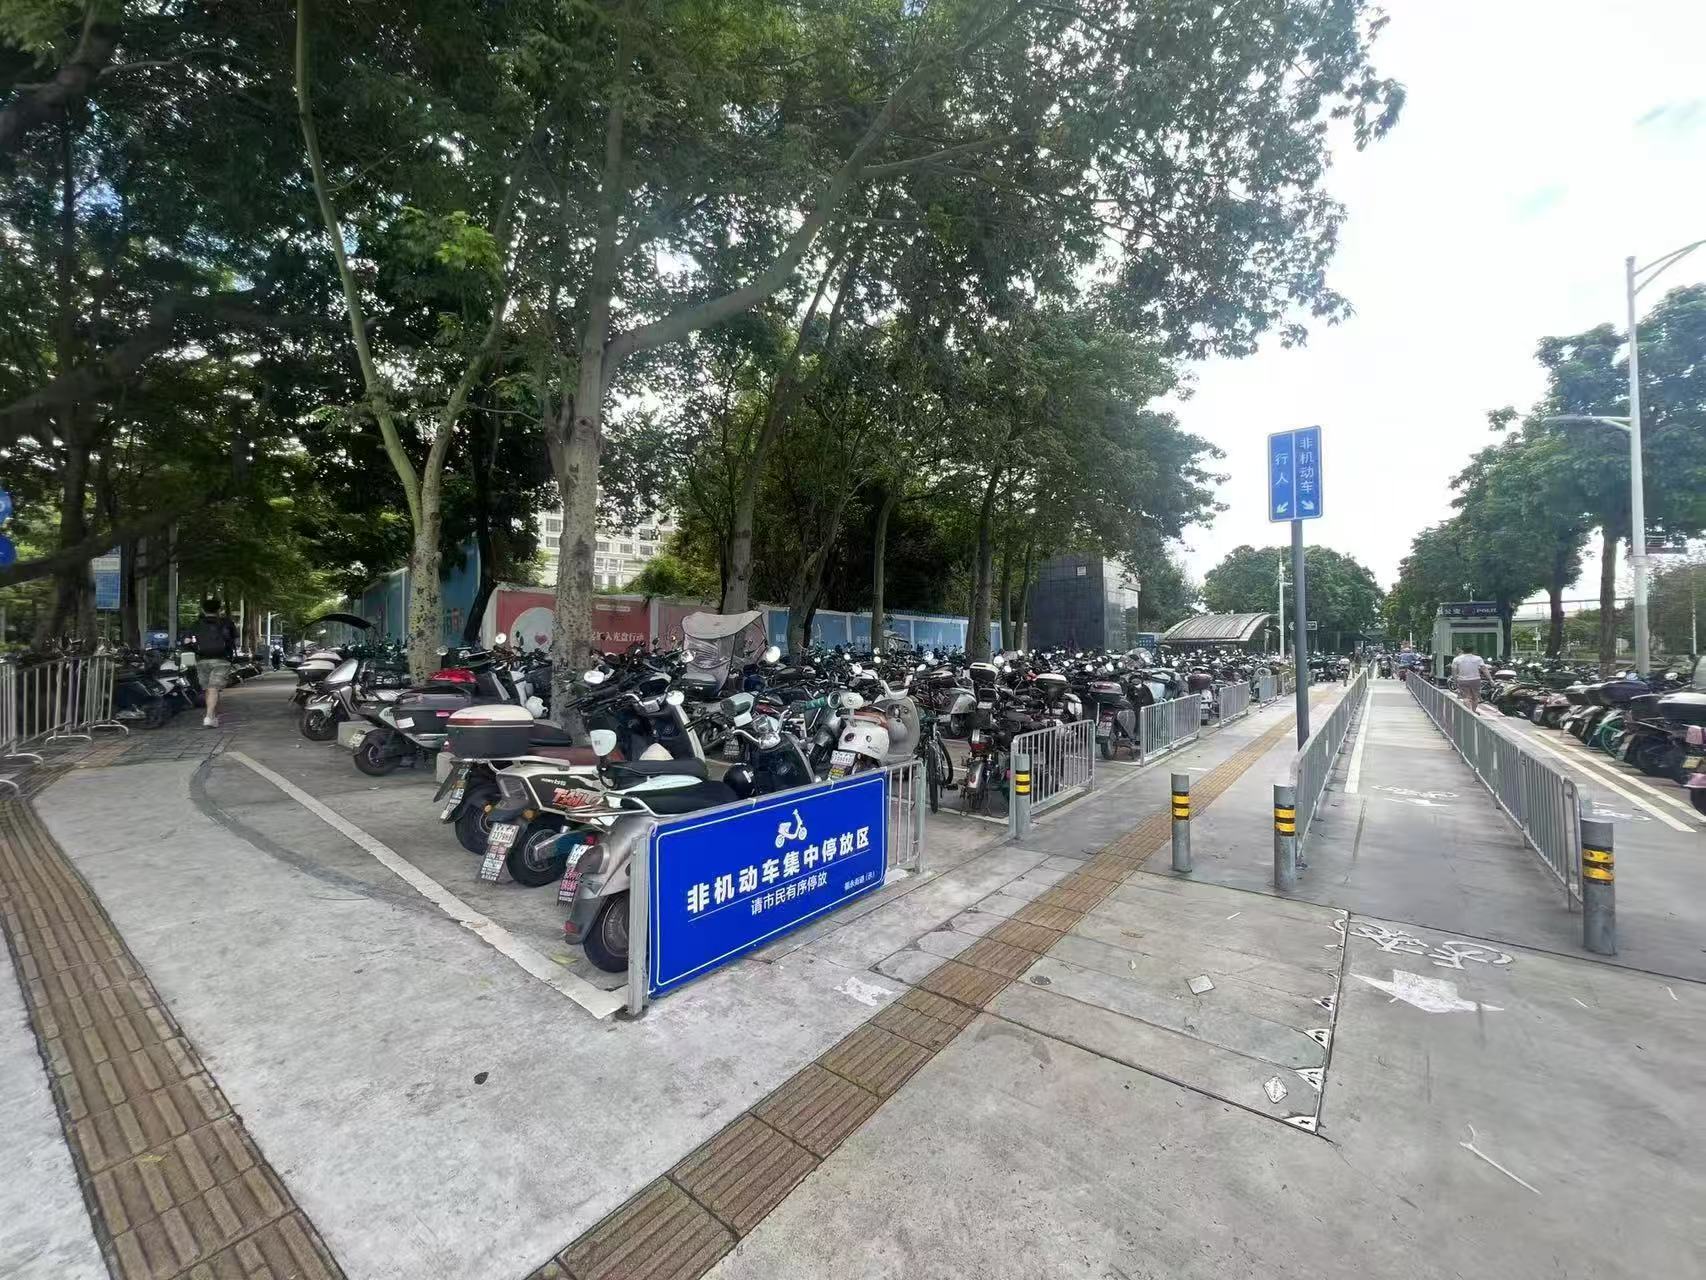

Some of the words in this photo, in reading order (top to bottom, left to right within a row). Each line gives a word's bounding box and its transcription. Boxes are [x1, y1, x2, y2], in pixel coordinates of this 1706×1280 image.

[1275, 453, 1288, 485] 行人
[1299, 437, 1314, 493] 非机动车
[687, 826, 870, 914] 非机动车集中停放区
[750, 871, 828, 916] 请市民有序停放
